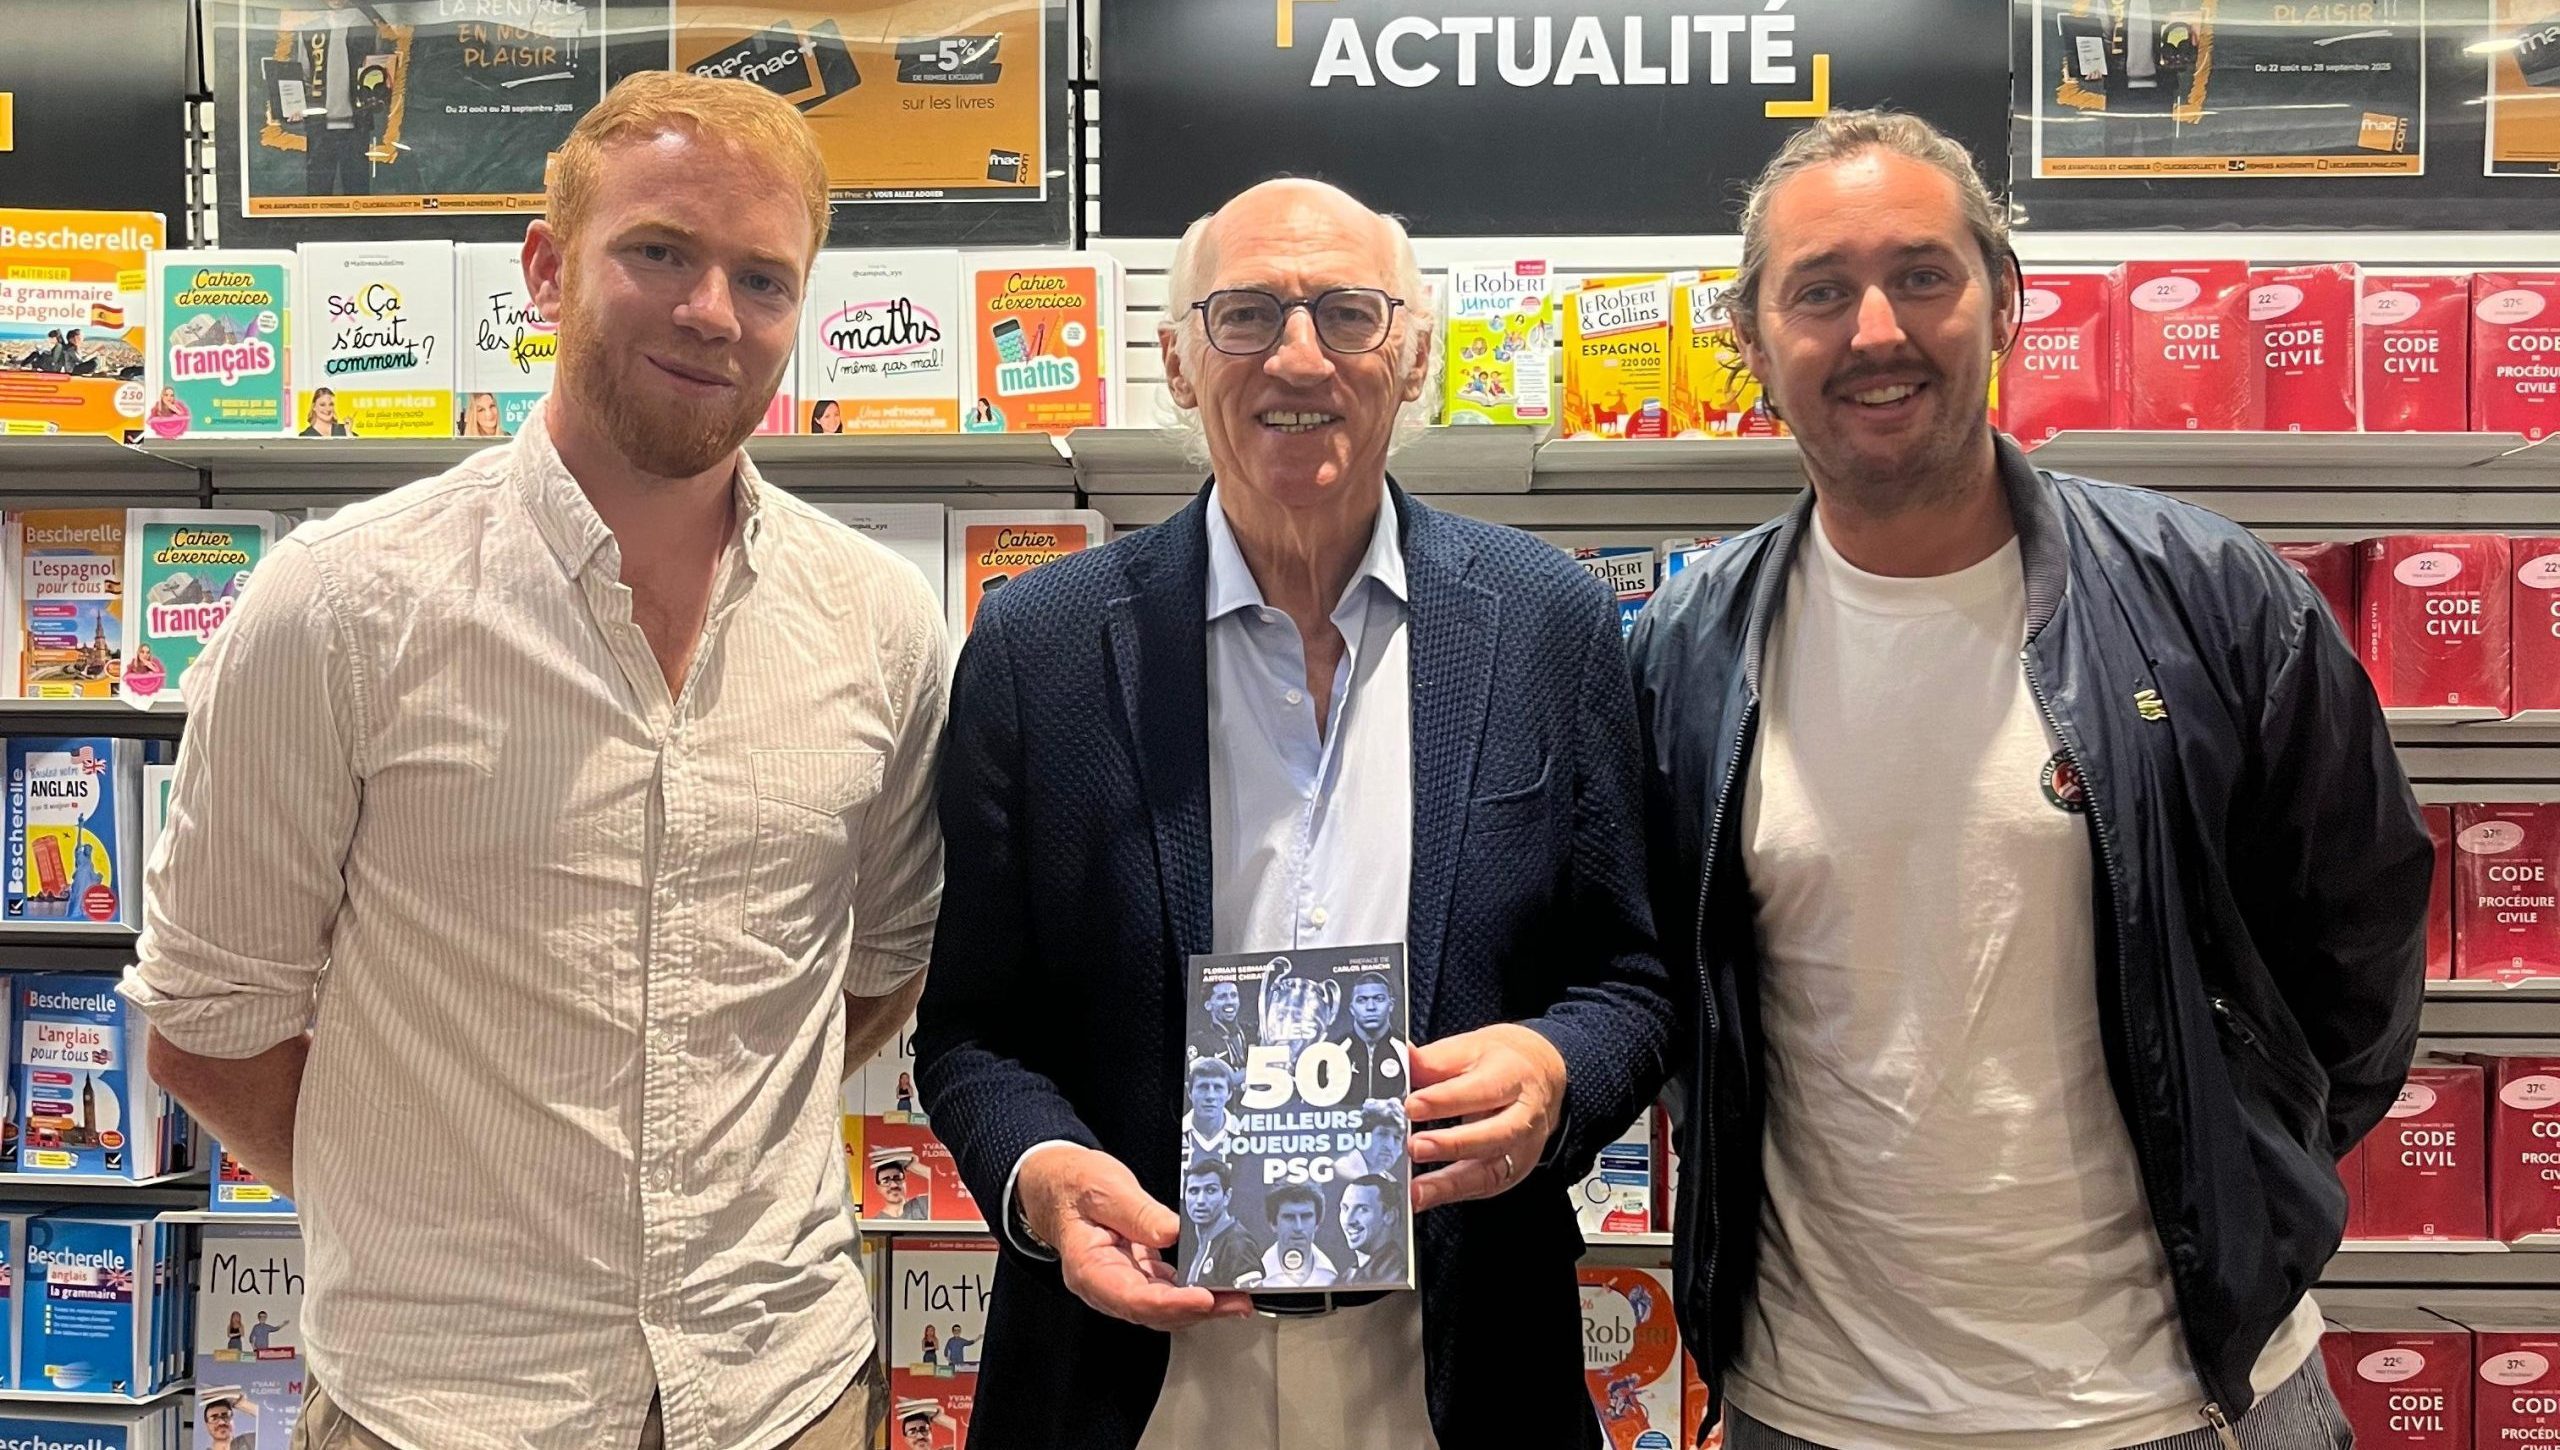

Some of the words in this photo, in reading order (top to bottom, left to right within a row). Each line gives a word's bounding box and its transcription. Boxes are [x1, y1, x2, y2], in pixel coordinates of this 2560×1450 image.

[1310, 0, 1796, 88] ACTUALITÉ
[464, 47, 556, 67] PLAISIR
[2255, 64, 2267, 72] Du
[2269, 64, 2279, 72] 22
[2326, 63, 2369, 73] septembre
[446, 105, 457, 113] Du
[459, 105, 468, 113] 22
[512, 105, 553, 115] septembre
[902, 99, 925, 110] sur
[930, 96, 951, 110] les
[956, 95, 995, 109] livres
[2361, 118, 2396, 131] fnac
[989, 154, 1020, 166] fnac
[874, 190, 893, 198] VOUS
[894, 190, 914, 198] ALLEZ
[0, 226, 154, 250] Bescherelle
[195, 269, 253, 288] Cahier
[1007, 273, 1066, 294] Cahier
[18, 284, 113, 303] grammaire
[178, 289, 269, 306] d'exercices
[328, 295, 359, 315] Sa
[366, 283, 400, 321] Ça
[991, 294, 1082, 309] d'exercices
[0, 302, 86, 322] espagnole
[843, 300, 873, 323] Les
[1456, 294, 1515, 315] junior
[829, 297, 941, 351] maths
[1598, 307, 1659, 327] Collins
[332, 316, 407, 350] s'écrit
[475, 319, 510, 351] les
[2163, 323, 2221, 339] CODE
[2264, 328, 2324, 348] CODE
[1582, 342, 1661, 356] ESPAGNOL
[2023, 335, 2080, 350] CODE
[2383, 337, 2439, 353] CODE
[327, 339, 420, 374] comment
[422, 335, 435, 365] ?
[2163, 344, 2221, 360] CIVIL
[2264, 348, 2324, 368] CIVIL
[174, 342, 270, 380] français
[840, 360, 878, 376] même
[882, 362, 908, 379] pas
[2024, 355, 2080, 370] CIVIL
[2383, 357, 2439, 373] CIVIL
[1001, 360, 1076, 392] maths
[121, 390, 143, 400] 250
[2515, 381, 2557, 394] CIVILE
[26, 524, 122, 543] Bescherelle
[173, 527, 231, 547] Cahier
[997, 528, 1056, 548] Cahier
[157, 548, 246, 564] d'exercices
[32, 559, 116, 581] L'espagnol
[36, 582, 68, 598] pour
[72, 580, 101, 594] tous
[2425, 599, 2482, 615] CODE
[2425, 620, 2482, 635] CIVIL
[31, 780, 88, 798] ANGLAIS
[8, 767, 24, 893] Bescherelle
[2488, 866, 2545, 882] CODE
[2478, 894, 2555, 908] PROCÉDURE
[2496, 912, 2537, 923] CIVILE
[1203, 966, 1236, 975] FLORIAN
[1333, 965, 1360, 974] CARLOS
[1361, 963, 1391, 972] BIANCHI
[1203, 974, 1237, 982] ANTOINE
[28, 990, 117, 1012] Bescherelle
[38, 1024, 100, 1048] L'anglais
[30, 1047, 58, 1063] pour
[61, 1048, 89, 1062] tous
[1240, 1041, 1352, 1110] 50
[1231, 1109, 1363, 1134] MEILLEURS
[1219, 1135, 1331, 1155] JOUEURS
[1336, 1132, 1372, 1151] DU
[2400, 1130, 2456, 1146] CODE
[2401, 1151, 2456, 1166] CIVIL
[1263, 1156, 1334, 1184] PSG
[28, 1245, 125, 1270] Bescherelle
[51, 1269, 88, 1285] anglais
[50, 1285, 60, 1296] la
[62, 1287, 117, 1300] grammaire
[2389, 1395, 2444, 1411] CODE
[2512, 1397, 2560, 1414] COD
[2389, 1415, 2444, 1431] CIVIL
